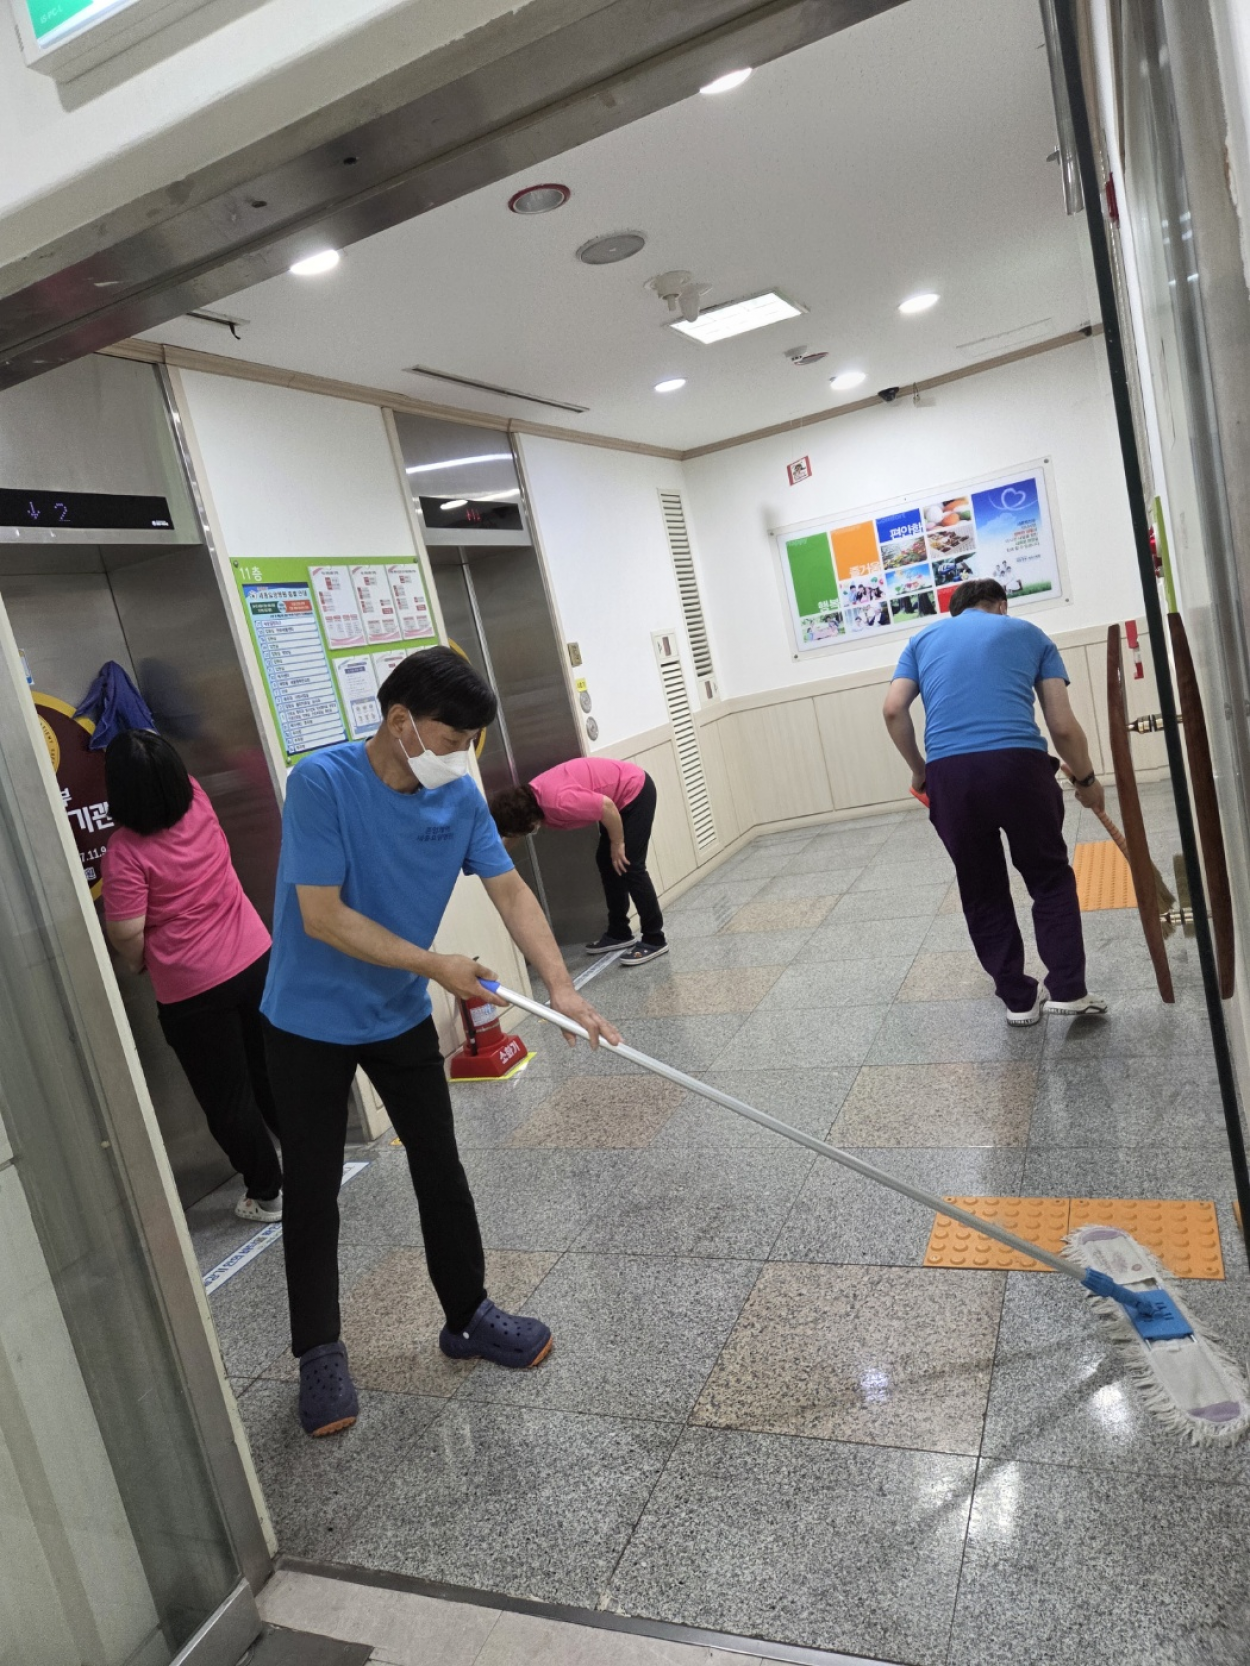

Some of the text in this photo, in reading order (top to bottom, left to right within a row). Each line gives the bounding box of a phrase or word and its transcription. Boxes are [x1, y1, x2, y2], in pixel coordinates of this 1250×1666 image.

[889, 521, 924, 541] 편안한
[239, 565, 263, 582] 11층
[849, 561, 881, 579] 즐거운
[67, 801, 115, 833] 기관
[499, 1039, 521, 1065] 소화기
